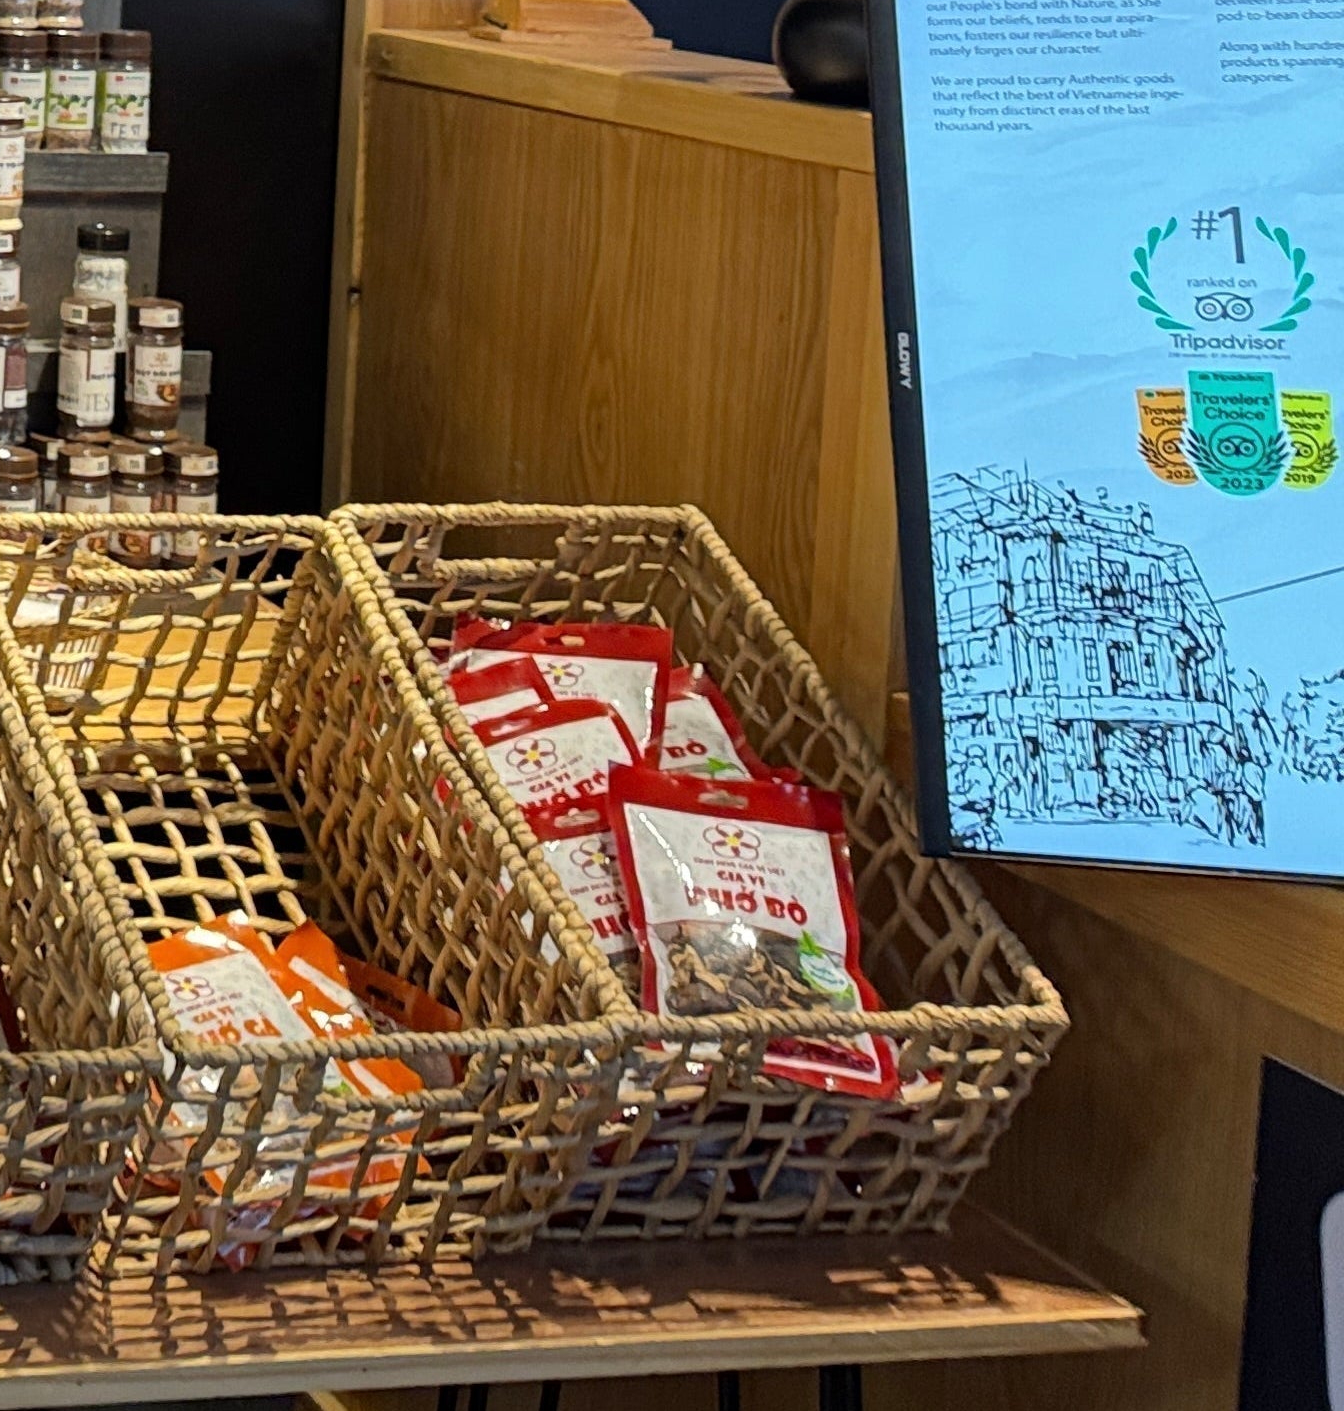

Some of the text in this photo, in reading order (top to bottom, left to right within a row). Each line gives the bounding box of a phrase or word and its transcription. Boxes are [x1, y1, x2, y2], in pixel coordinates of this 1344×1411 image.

[927, 3, 947, 11] our
[1004, 0, 1037, 9] bond
[1041, 0, 1069, 8] with
[965, 17, 986, 25] our
[1037, 14, 1071, 25] tends
[1074, 15, 1088, 24] to
[1091, 15, 1112, 23] our
[965, 30, 1007, 41] fosters
[1009, 31, 1030, 40] our
[1034, 28, 1093, 39] resilience
[1096, 28, 1117, 38] but
[930, 46, 971, 57] mately
[974, 45, 1013, 57] forges
[1016, 45, 1038, 54] our
[931, 72, 1175, 87] We are proud to carry Authentic goods
[933, 90, 958, 101] that
[961, 90, 1000, 100] reflect
[1003, 89, 1023, 100] the
[1027, 89, 1054, 100] best
[1057, 89, 1071, 100] of
[1072, 89, 1148, 99] Vietnamese
[934, 105, 965, 117] nuity
[969, 105, 999, 116] from
[1059, 106, 1085, 115] eras
[1088, 104, 1100, 115] of
[1103, 104, 1124, 114] the
[1128, 103, 1149, 114] last
[935, 121, 994, 131] thousand
[1191, 206, 1245, 264] #1
[1187, 277, 1257, 288] ranked on
[1169, 333, 1286, 352] Tripadvisor
[1192, 391, 1274, 406] Travelers'
[1204, 407, 1266, 421] Choice
[1220, 477, 1265, 491] 2023
